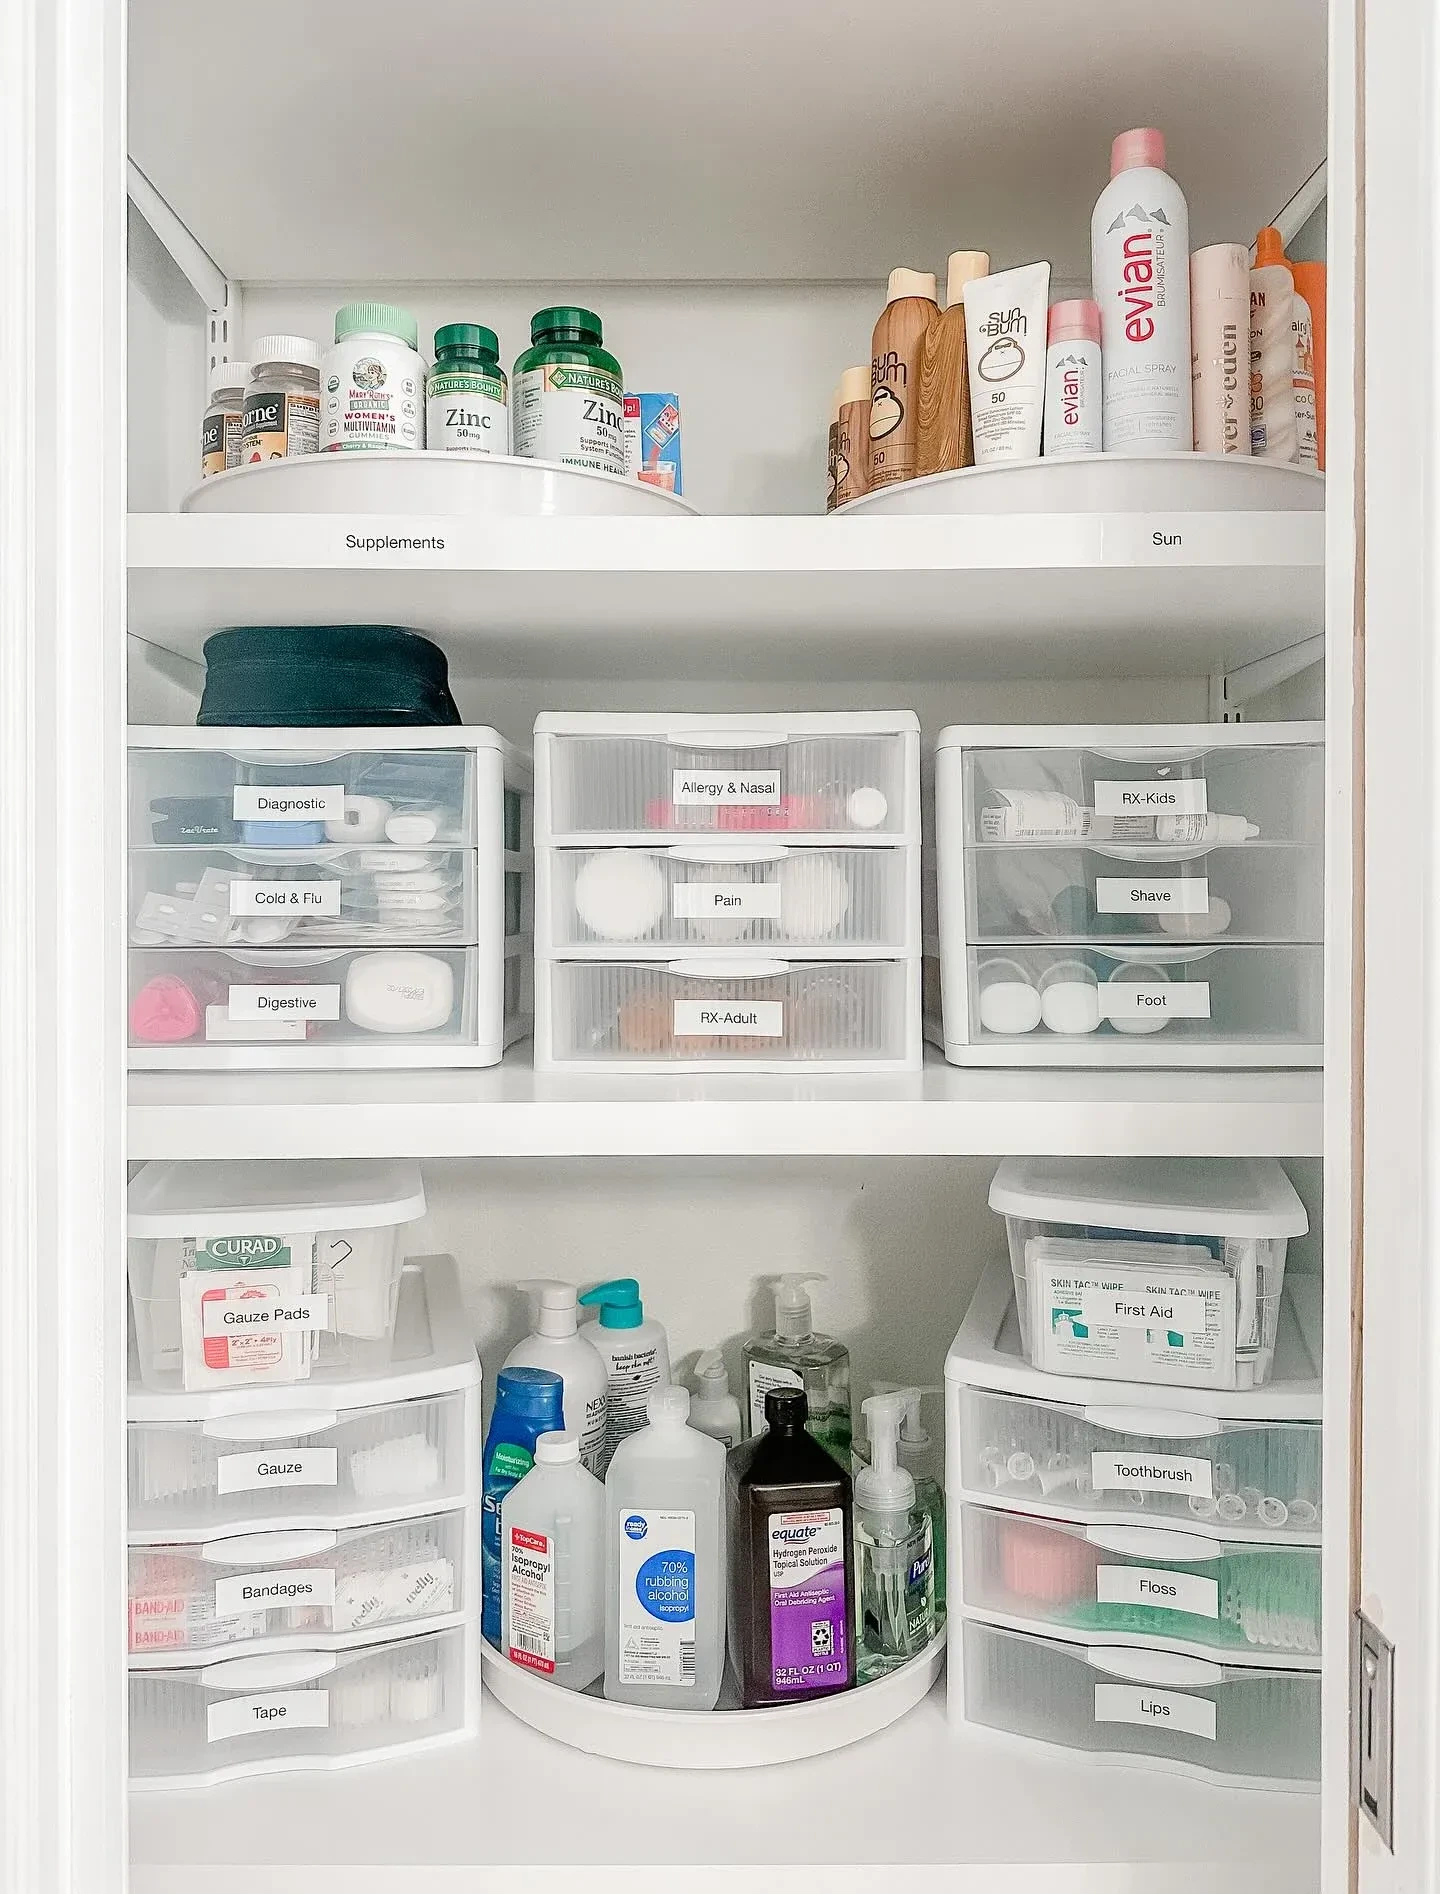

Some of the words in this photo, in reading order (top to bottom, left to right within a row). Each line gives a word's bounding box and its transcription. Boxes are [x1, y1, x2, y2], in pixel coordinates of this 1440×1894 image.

[1156, 234, 1166, 308] BRUMISATEUR
[1117, 231, 1155, 342] evian
[1250, 291, 1266, 307] AN
[1108, 365, 1141, 380] FACIAL
[1144, 363, 1177, 374] SPRAY
[434, 380, 469, 391] NATURE'S
[471, 382, 501, 395] BOUNTY
[567, 372, 610, 391] NATURE'S
[991, 391, 1006, 404] 50
[1060, 368, 1079, 426] evian
[344, 412, 396, 422] WOMEN'S
[445, 408, 492, 429] Zinc
[582, 399, 623, 433] Zinc
[343, 420, 396, 435] MULTIVITAMIN
[456, 428, 469, 438] 50
[596, 426, 608, 438] 50
[348, 432, 390, 441] GUMMIES
[873, 452, 885, 465] 50
[345, 534, 445, 552] Supplements
[1152, 531, 1182, 546] Sun
[681, 781, 724, 796] Allergy
[727, 782, 737, 794] &
[740, 781, 775, 794] Nasal
[258, 797, 326, 813] Diagnostic
[1122, 792, 1176, 805] RX-Kids
[255, 892, 286, 904] Cold
[289, 892, 300, 904] &
[303, 892, 322, 904] Flu
[714, 894, 742, 906] Pain
[1130, 889, 1172, 902] Shave
[257, 996, 317, 1012] Digestive
[1136, 994, 1167, 1007] Foot
[700, 1011, 758, 1025] RX-Adult
[212, 1239, 278, 1257] CURAD
[1050, 1278, 1071, 1288] SKIN
[1101, 1282, 1124, 1291] WIPE
[1145, 1285, 1167, 1295] SKIN
[1198, 1290, 1221, 1300] WIPE
[223, 1311, 270, 1325] Gauze
[274, 1307, 310, 1321] Pads
[1115, 1302, 1146, 1317] First
[1149, 1305, 1173, 1319] Aid
[257, 1463, 303, 1476] Gauze
[1113, 1463, 1193, 1482] Toothbrush
[772, 1526, 817, 1541] equate
[512, 1546, 524, 1554] 70%
[772, 1548, 807, 1559] Hydrogen
[808, 1544, 838, 1556] Peroxide
[511, 1553, 551, 1573] Isopropyl
[661, 1561, 688, 1573] 70%
[772, 1560, 799, 1570] Topical
[799, 1557, 828, 1567] Solution
[512, 1564, 544, 1582] Alcohol
[645, 1576, 689, 1590] rubbing
[1139, 1579, 1177, 1597] Floss
[241, 1582, 313, 1600] Bandages
[648, 1589, 689, 1600] alcohol
[801, 1588, 830, 1597] Antiseptic
[135, 1600, 184, 1615] BAND-AID
[774, 1599, 787, 1607] Oral
[818, 1594, 836, 1603] Agent
[775, 1668, 787, 1677] 32
[788, 1667, 800, 1676] FL
[801, 1665, 815, 1675] OZ
[816, 1664, 824, 1675] (1
[826, 1662, 841, 1672] QT)
[775, 1676, 806, 1685] 946mL
[252, 1706, 287, 1721] Tape
[1141, 1699, 1171, 1717] Lips
